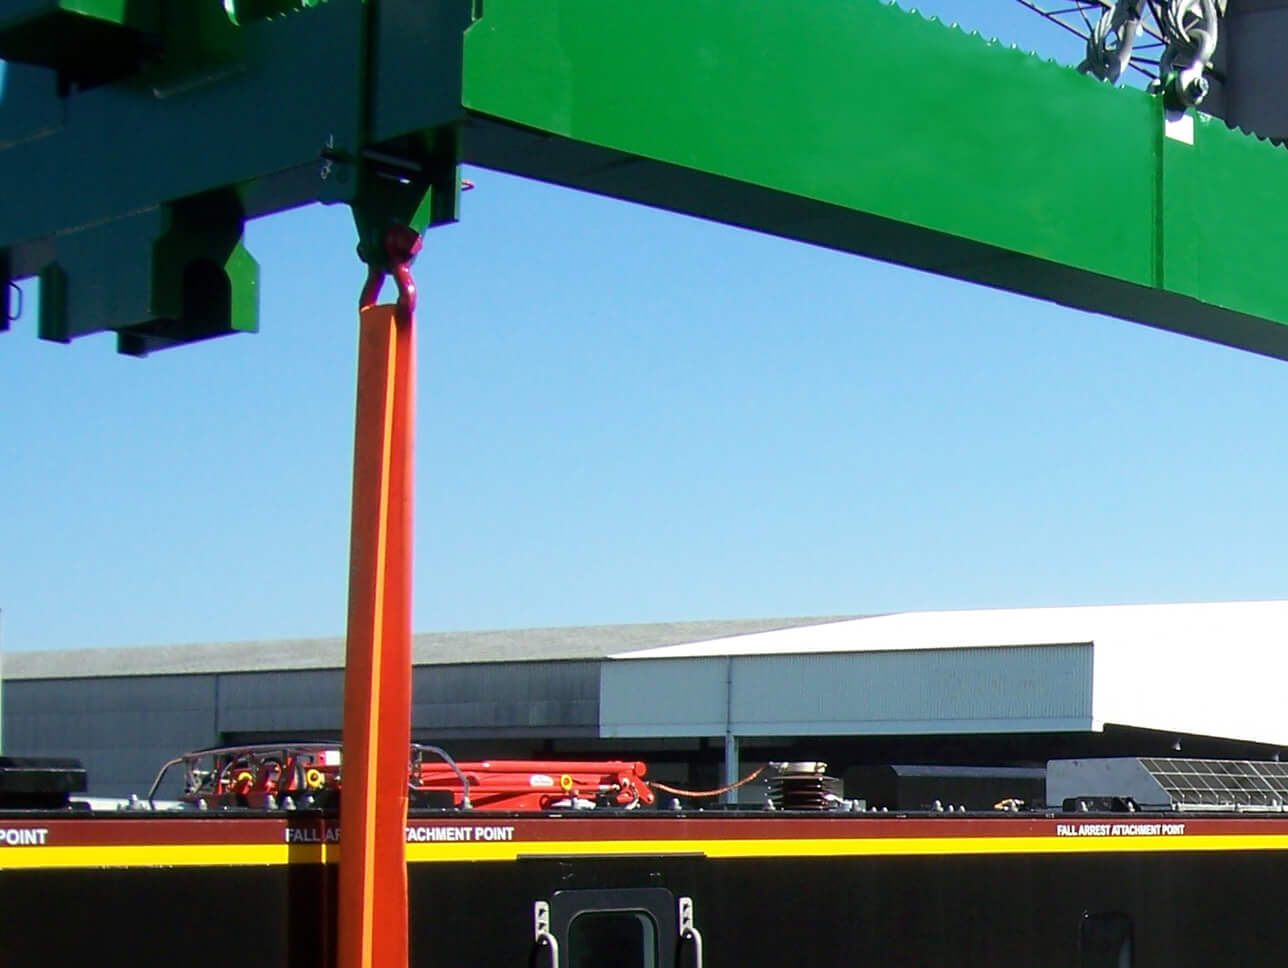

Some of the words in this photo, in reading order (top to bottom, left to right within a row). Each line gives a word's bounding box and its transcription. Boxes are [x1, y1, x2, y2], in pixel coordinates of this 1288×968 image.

[0, 828, 48, 845] POINT
[285, 827, 321, 842] FALL
[403, 826, 473, 842] TACHMENT
[475, 826, 514, 842] POINT
[1057, 824, 1077, 836] FALL
[1079, 824, 1111, 836] ARREST
[1111, 824, 1161, 836] ATTACHMENT
[1162, 824, 1185, 835] POINT
